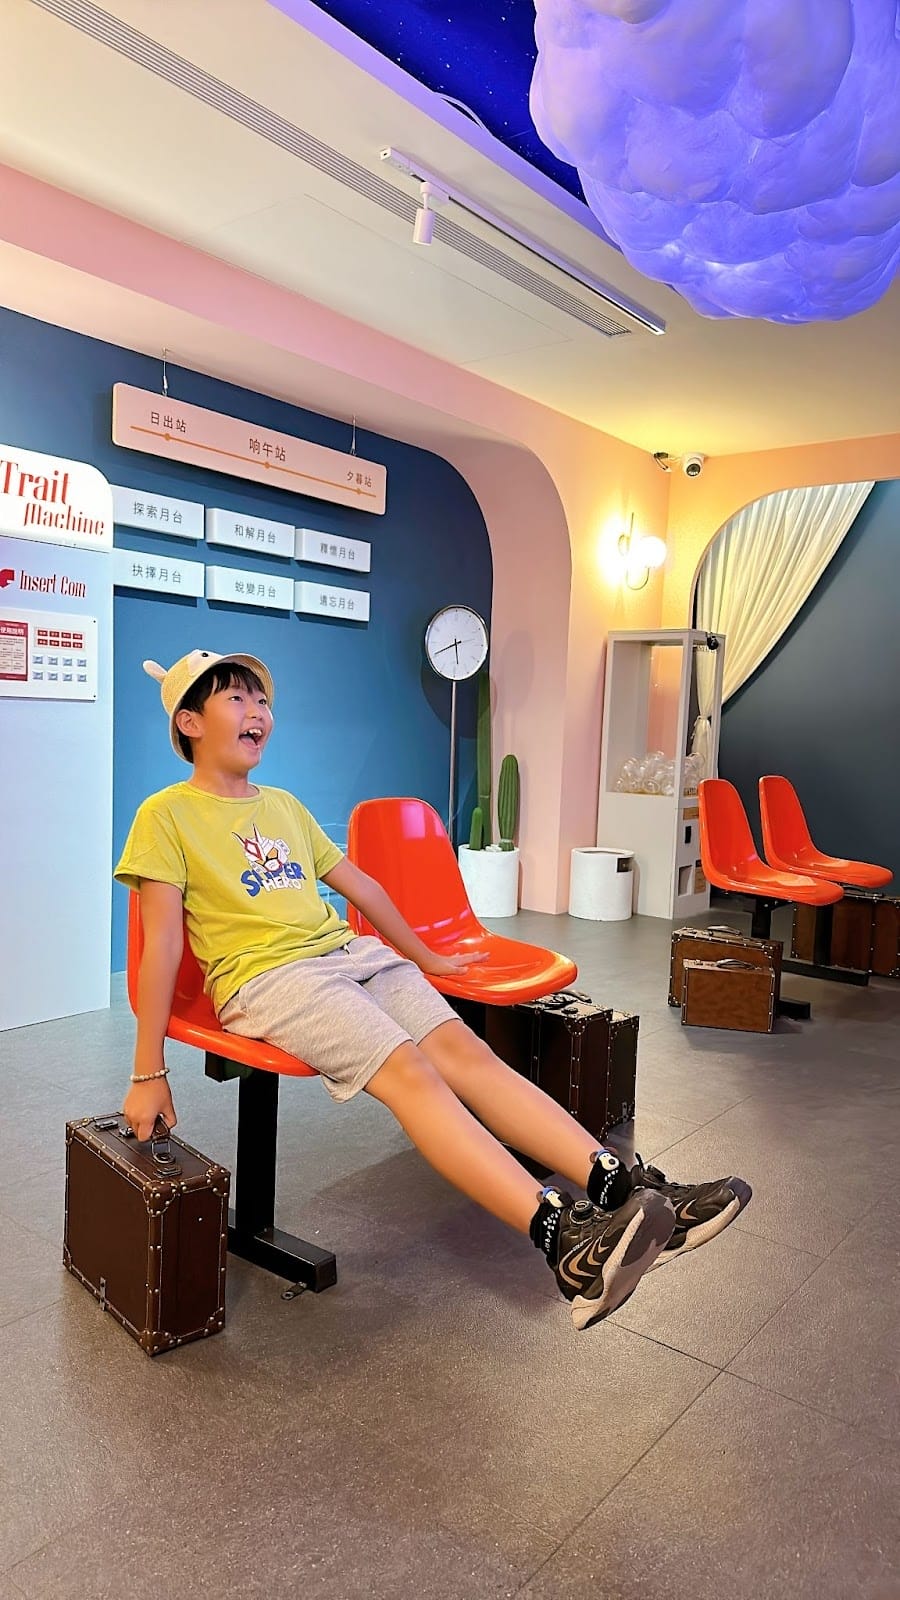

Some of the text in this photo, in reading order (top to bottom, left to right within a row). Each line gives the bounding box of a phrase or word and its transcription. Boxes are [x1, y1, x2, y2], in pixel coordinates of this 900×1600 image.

[150, 411, 187, 433] 日出站
[0, 460, 70, 504] Trait
[23, 503, 105, 536] Machine
[133, 501, 183, 524] 探索月台
[234, 524, 276, 544] 和解月台
[19, 569, 57, 595] Insert
[132, 563, 182, 583] 抉擇月台
